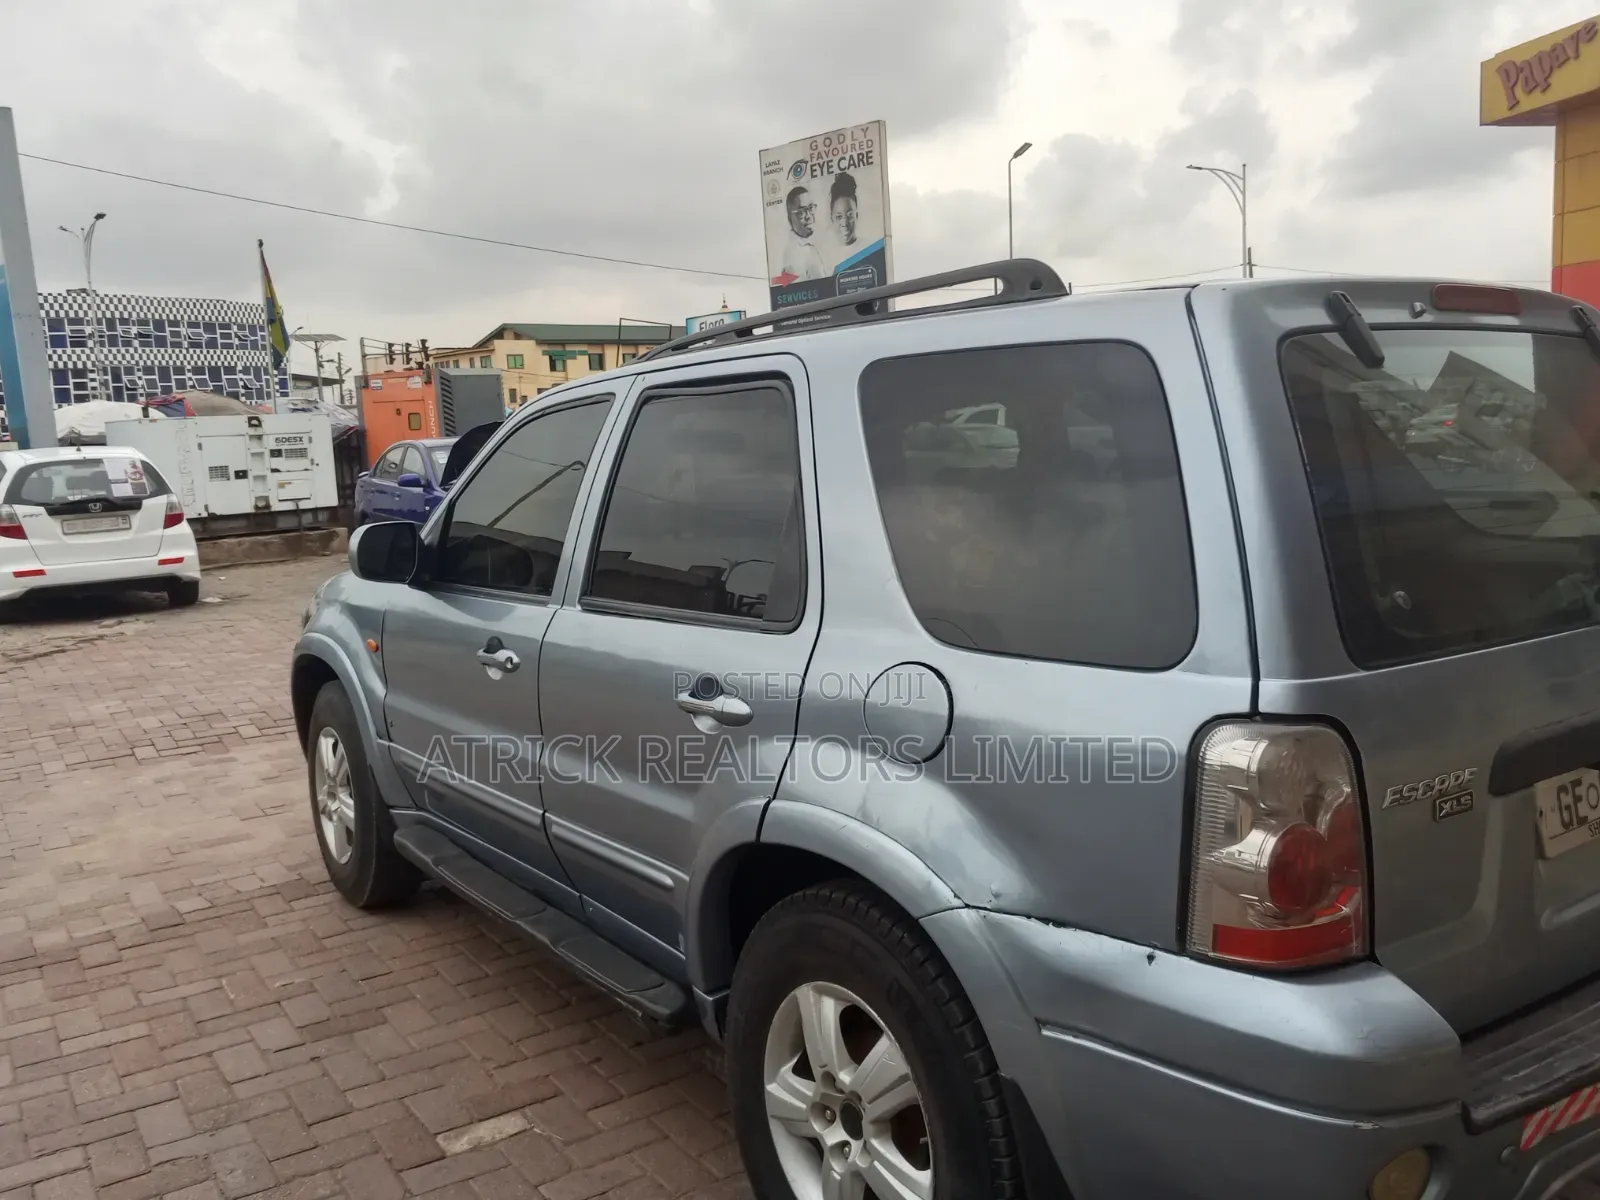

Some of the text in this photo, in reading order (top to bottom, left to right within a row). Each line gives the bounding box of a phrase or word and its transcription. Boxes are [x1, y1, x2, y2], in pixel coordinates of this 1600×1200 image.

[1495, 21, 1598, 111] Papaye
[809, 126, 869, 151] GODLY
[809, 139, 874, 163] FAVOURED
[763, 166, 784, 176] BRANCH
[810, 150, 874, 179] EYE CARE
[777, 289, 819, 304] SERVICES
[1381, 767, 1478, 809] ESCAPE
[1439, 795, 1473, 817] XLS
